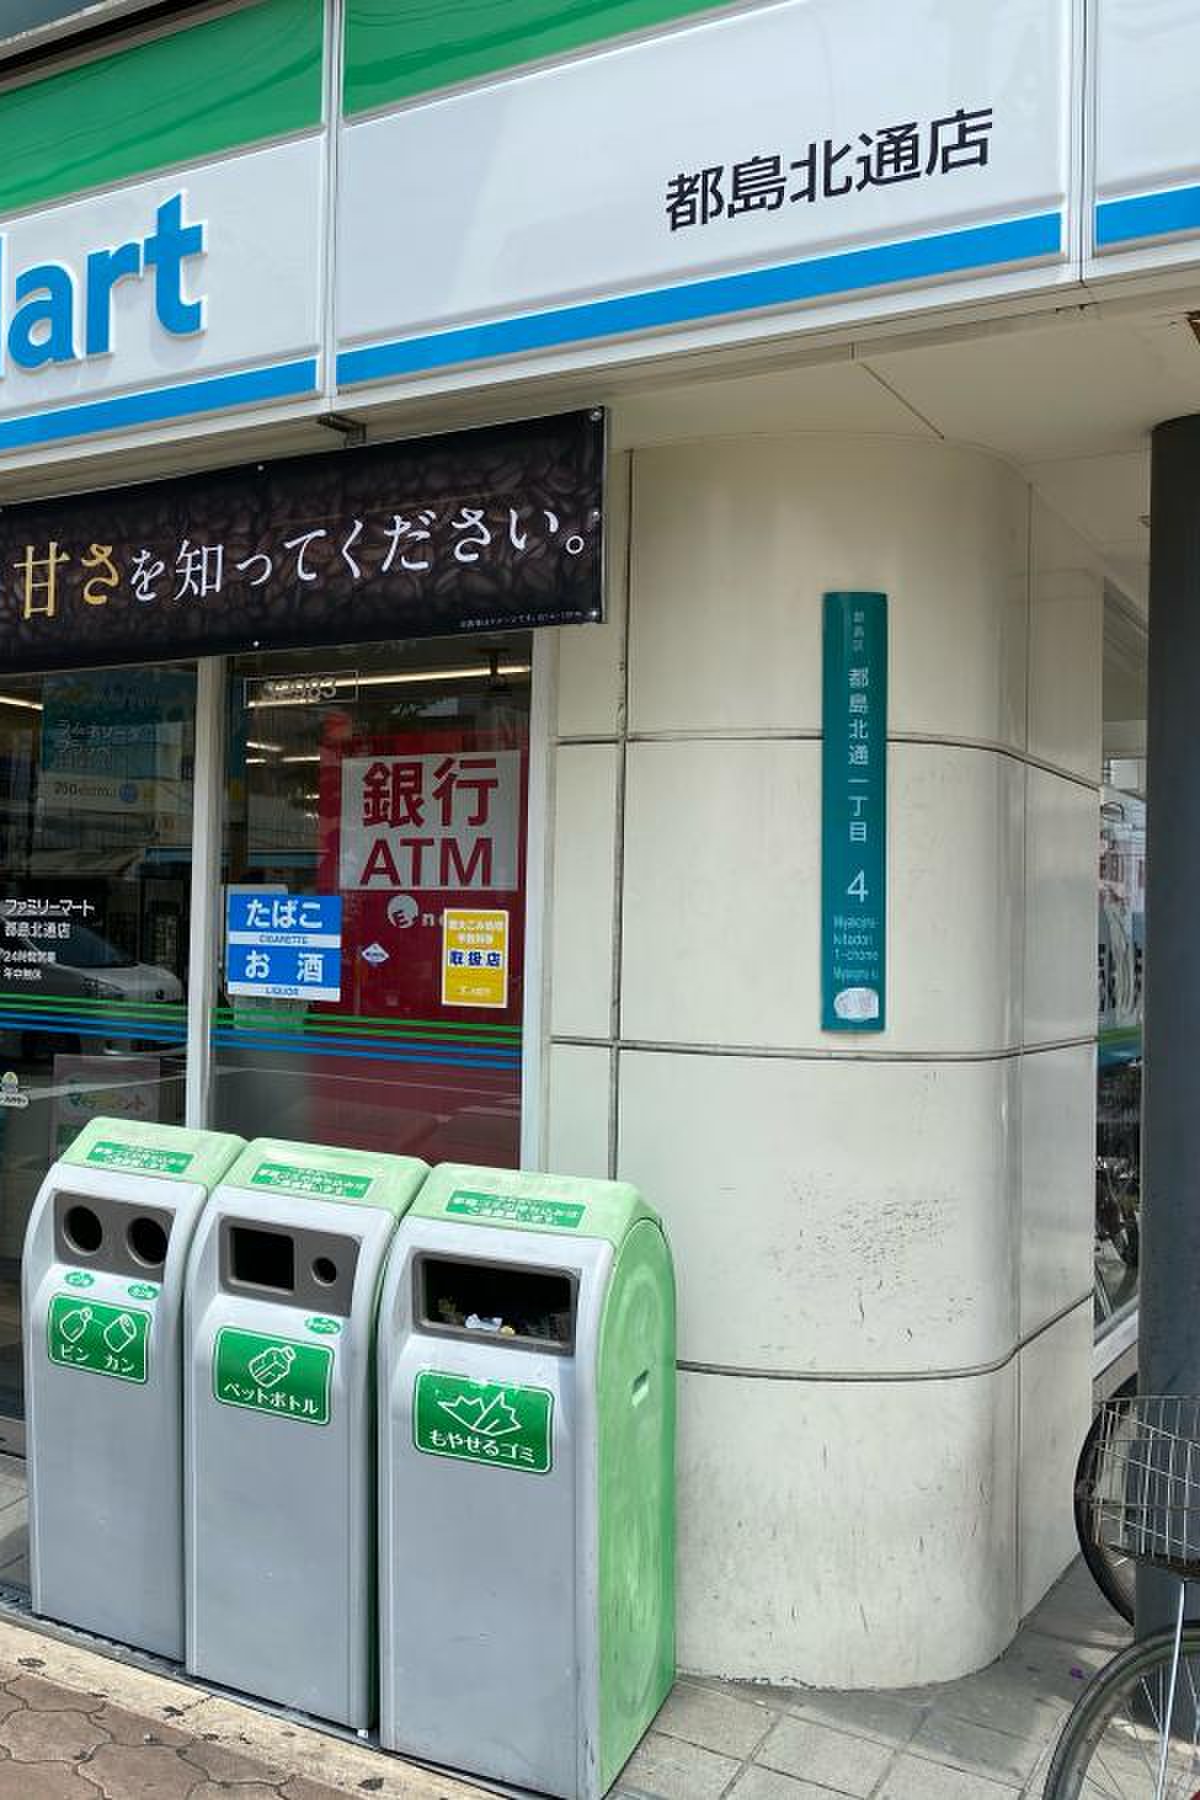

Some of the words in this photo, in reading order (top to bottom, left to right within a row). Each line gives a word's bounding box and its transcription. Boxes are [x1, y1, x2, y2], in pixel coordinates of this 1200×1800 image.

[666, 108, 993, 231] 都島北通店
[847, 666, 870, 843] 都島北通一丁目
[362, 757, 499, 829] 銀行
[359, 837, 493, 887] ATM
[847, 869, 870, 903] 4
[4, 898, 95, 917] ファミリーマート
[246, 899, 323, 929] たばこ
[61, 1343, 90, 1361] ビン
[102, 1354, 136, 1373] カン
[224, 1382, 320, 1415] ペットボトル
[429, 1429, 536, 1463] もやせるゴミ
